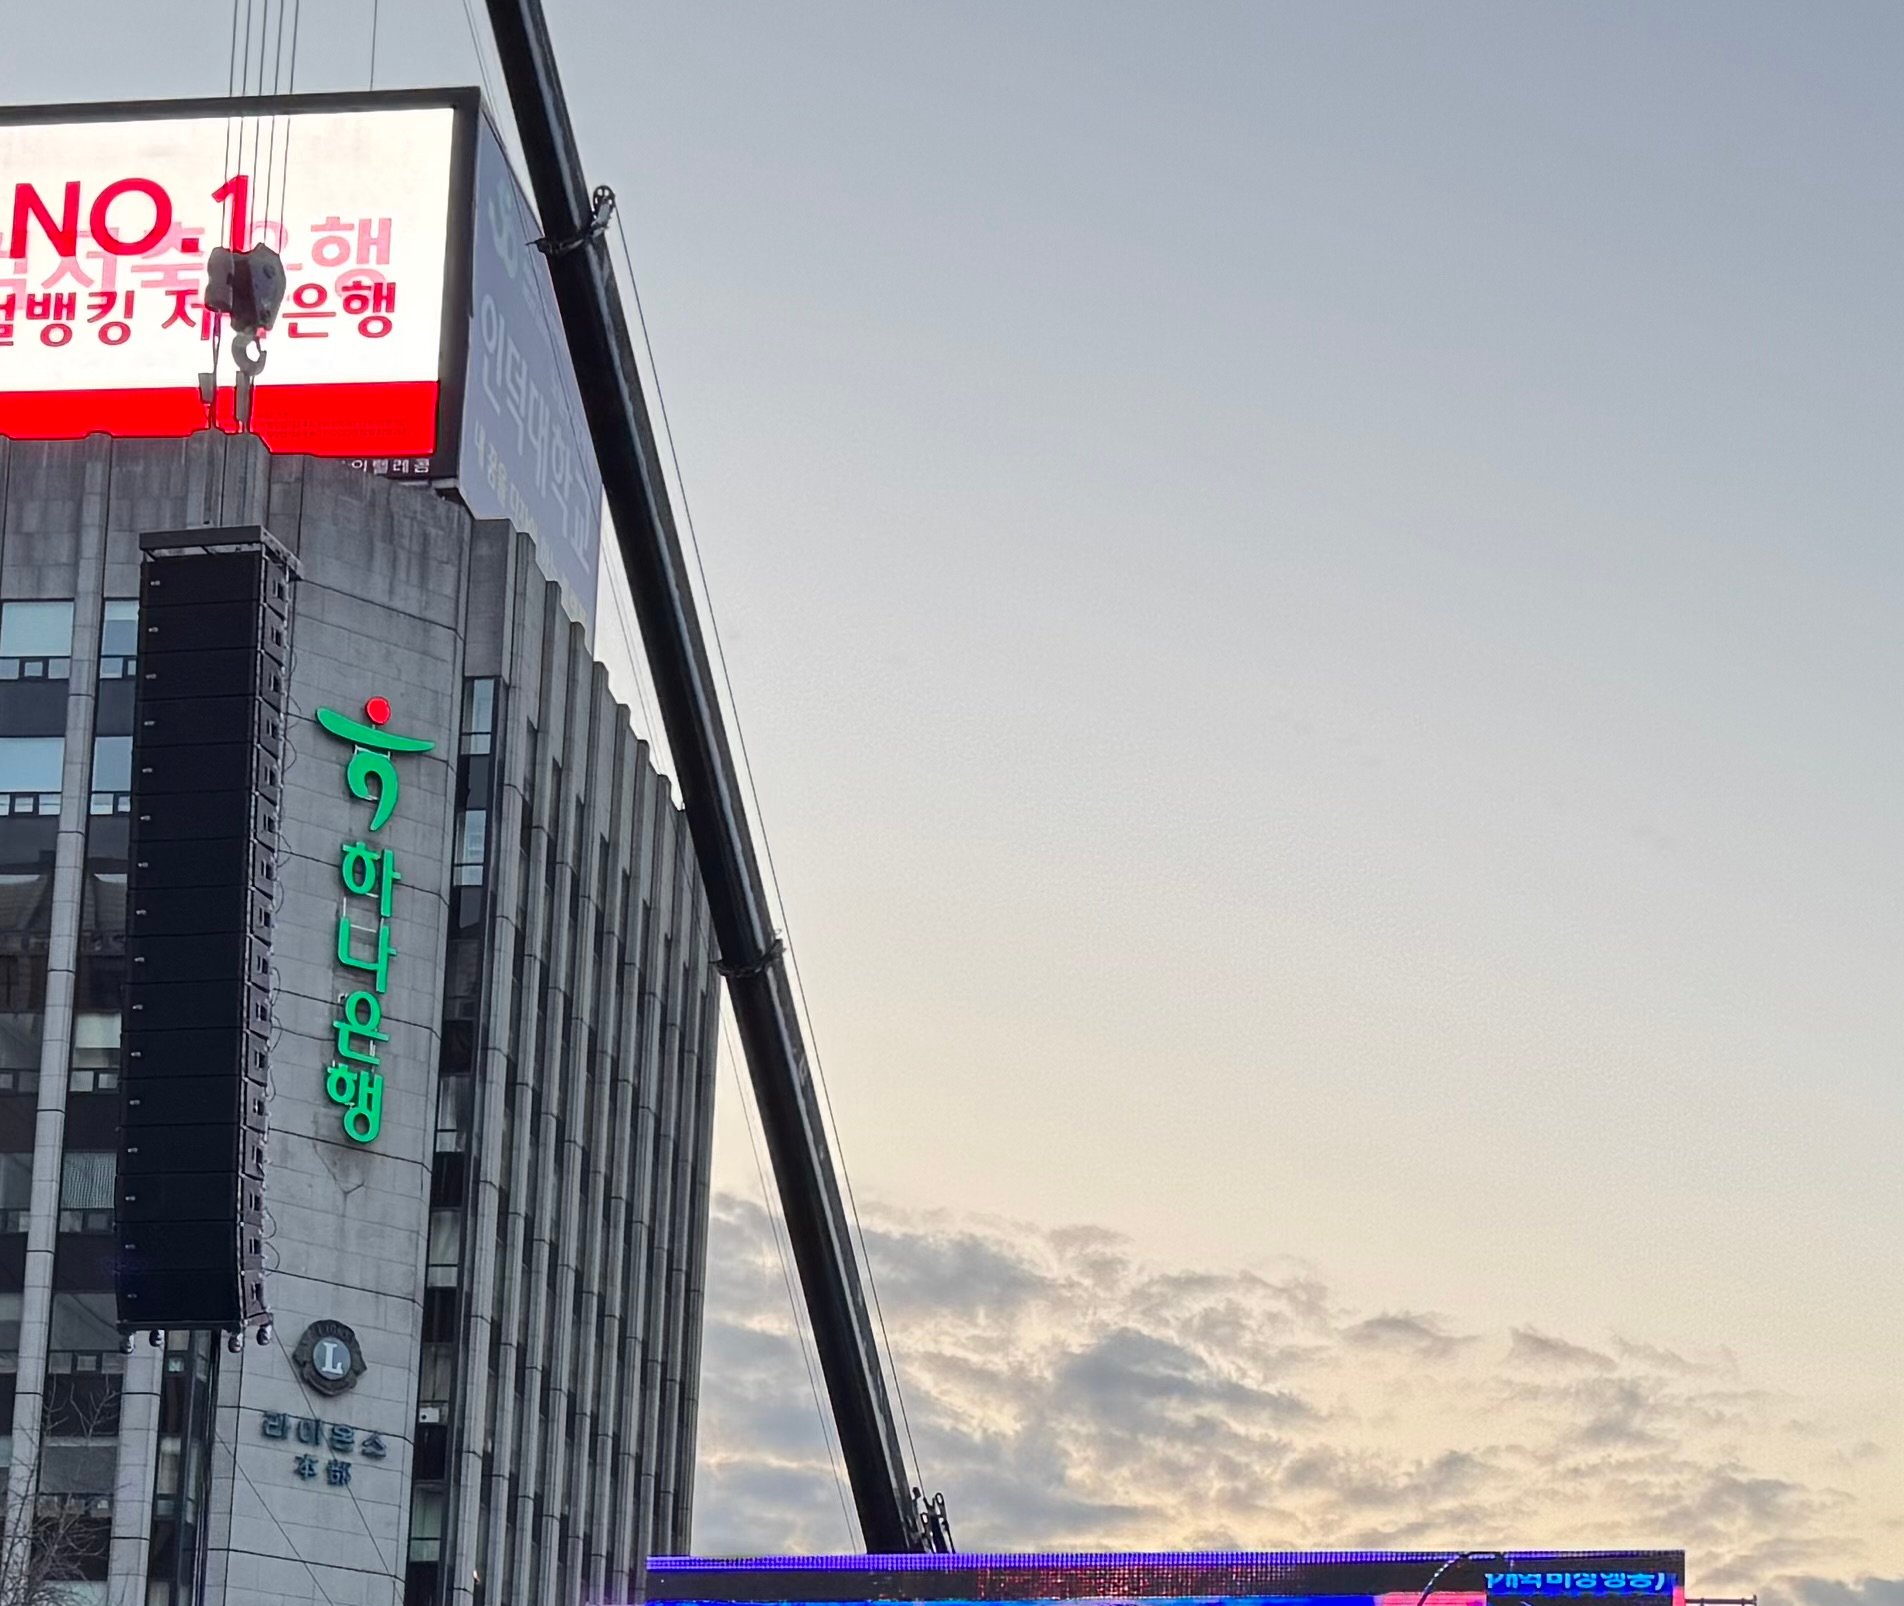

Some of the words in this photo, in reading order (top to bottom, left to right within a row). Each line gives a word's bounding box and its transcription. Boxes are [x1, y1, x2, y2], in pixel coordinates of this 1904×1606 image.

[9, 174, 251, 260] NO.1
[162, 281, 397, 345] 저은행
[327, 839, 402, 1145] 하나은행
[321, 1342, 344, 1375] L
